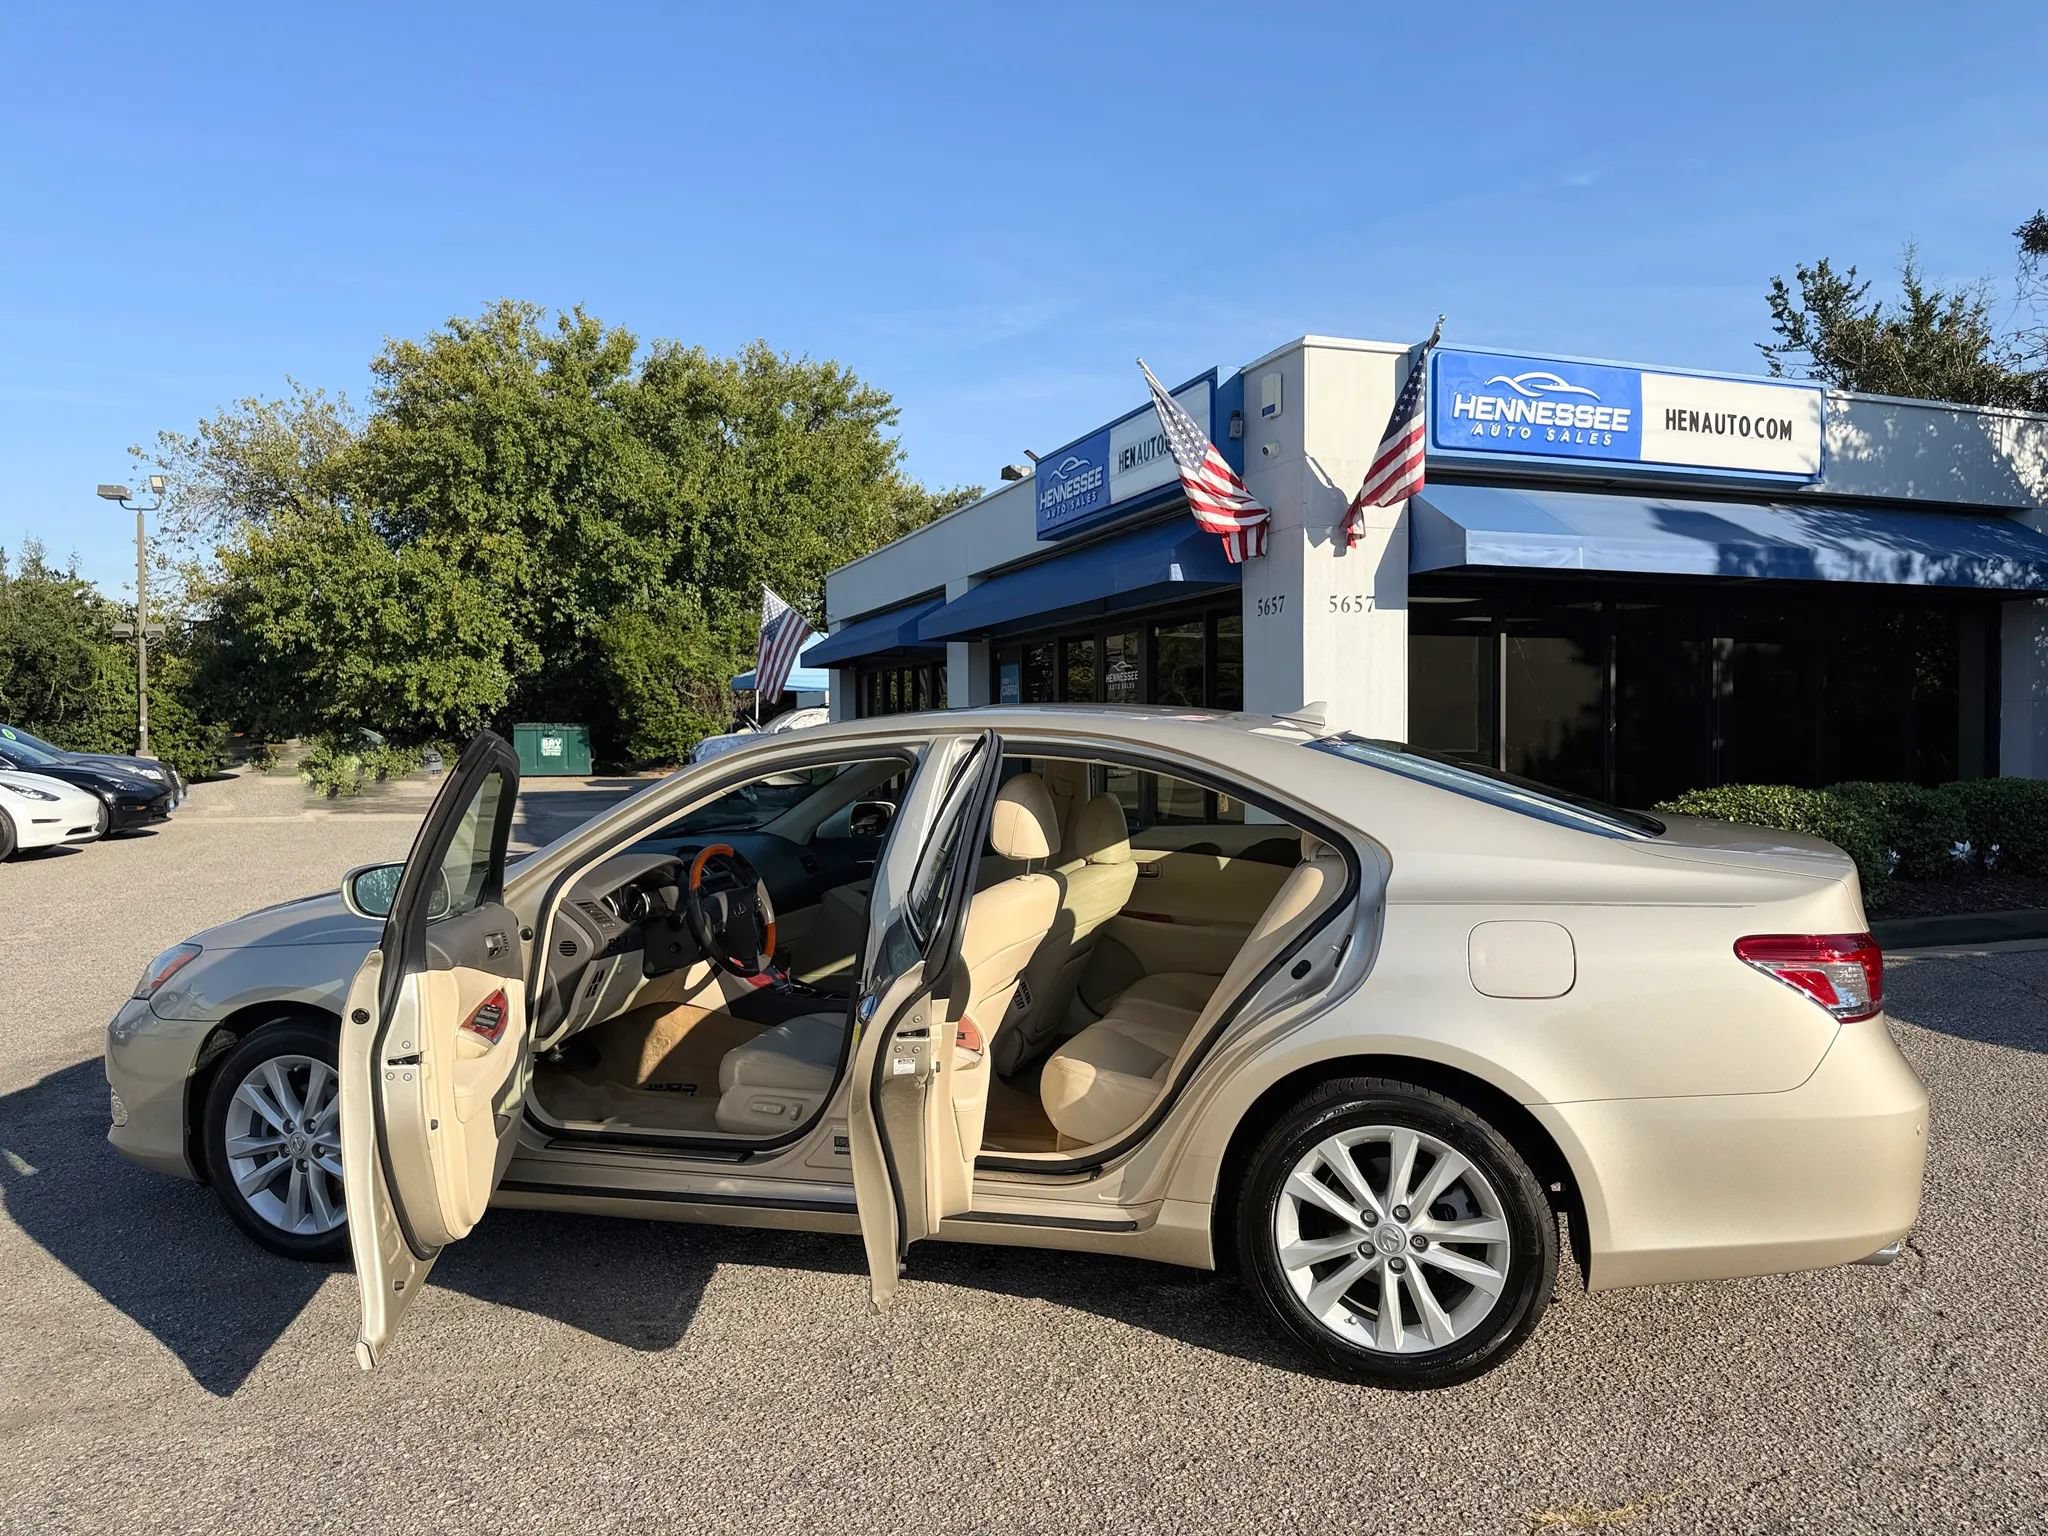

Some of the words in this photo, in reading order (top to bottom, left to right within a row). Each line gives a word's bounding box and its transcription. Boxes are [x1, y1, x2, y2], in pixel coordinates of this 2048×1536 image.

[1452, 393, 1631, 432] HENNESSEE
[1471, 422, 1532, 439] AUTO
[1545, 427, 1613, 446] SALES
[1039, 465, 1104, 511] HENNESSEE
[1047, 504, 1067, 520] AUTO
[1071, 491, 1098, 510] SALES
[1257, 594, 1285, 617] 5657
[1328, 594, 1376, 613] 5657
[1105, 671, 1139, 682] HENNESSEE
